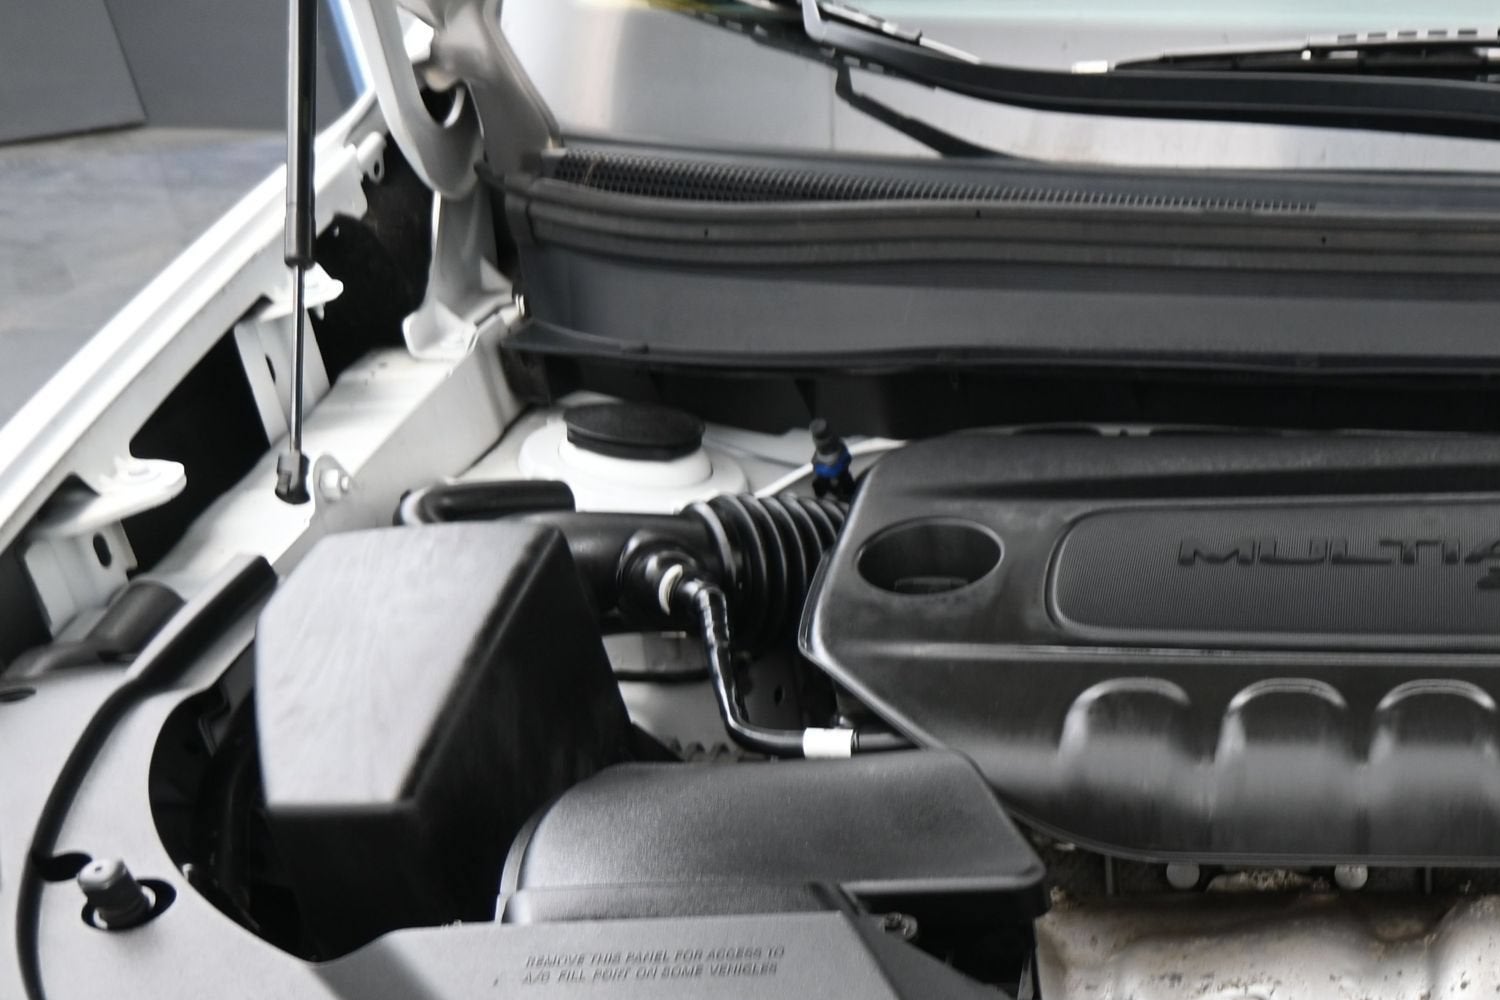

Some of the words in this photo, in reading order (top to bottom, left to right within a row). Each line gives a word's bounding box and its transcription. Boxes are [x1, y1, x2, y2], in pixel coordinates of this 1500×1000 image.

[525, 953, 585, 968] REMOVE
[591, 952, 621, 966] THIS
[625, 950, 669, 964] PANEL
[674, 948, 704, 962] FOR
[592, 966, 631, 982] PORT
[709, 961, 778, 977] VEHICLES
